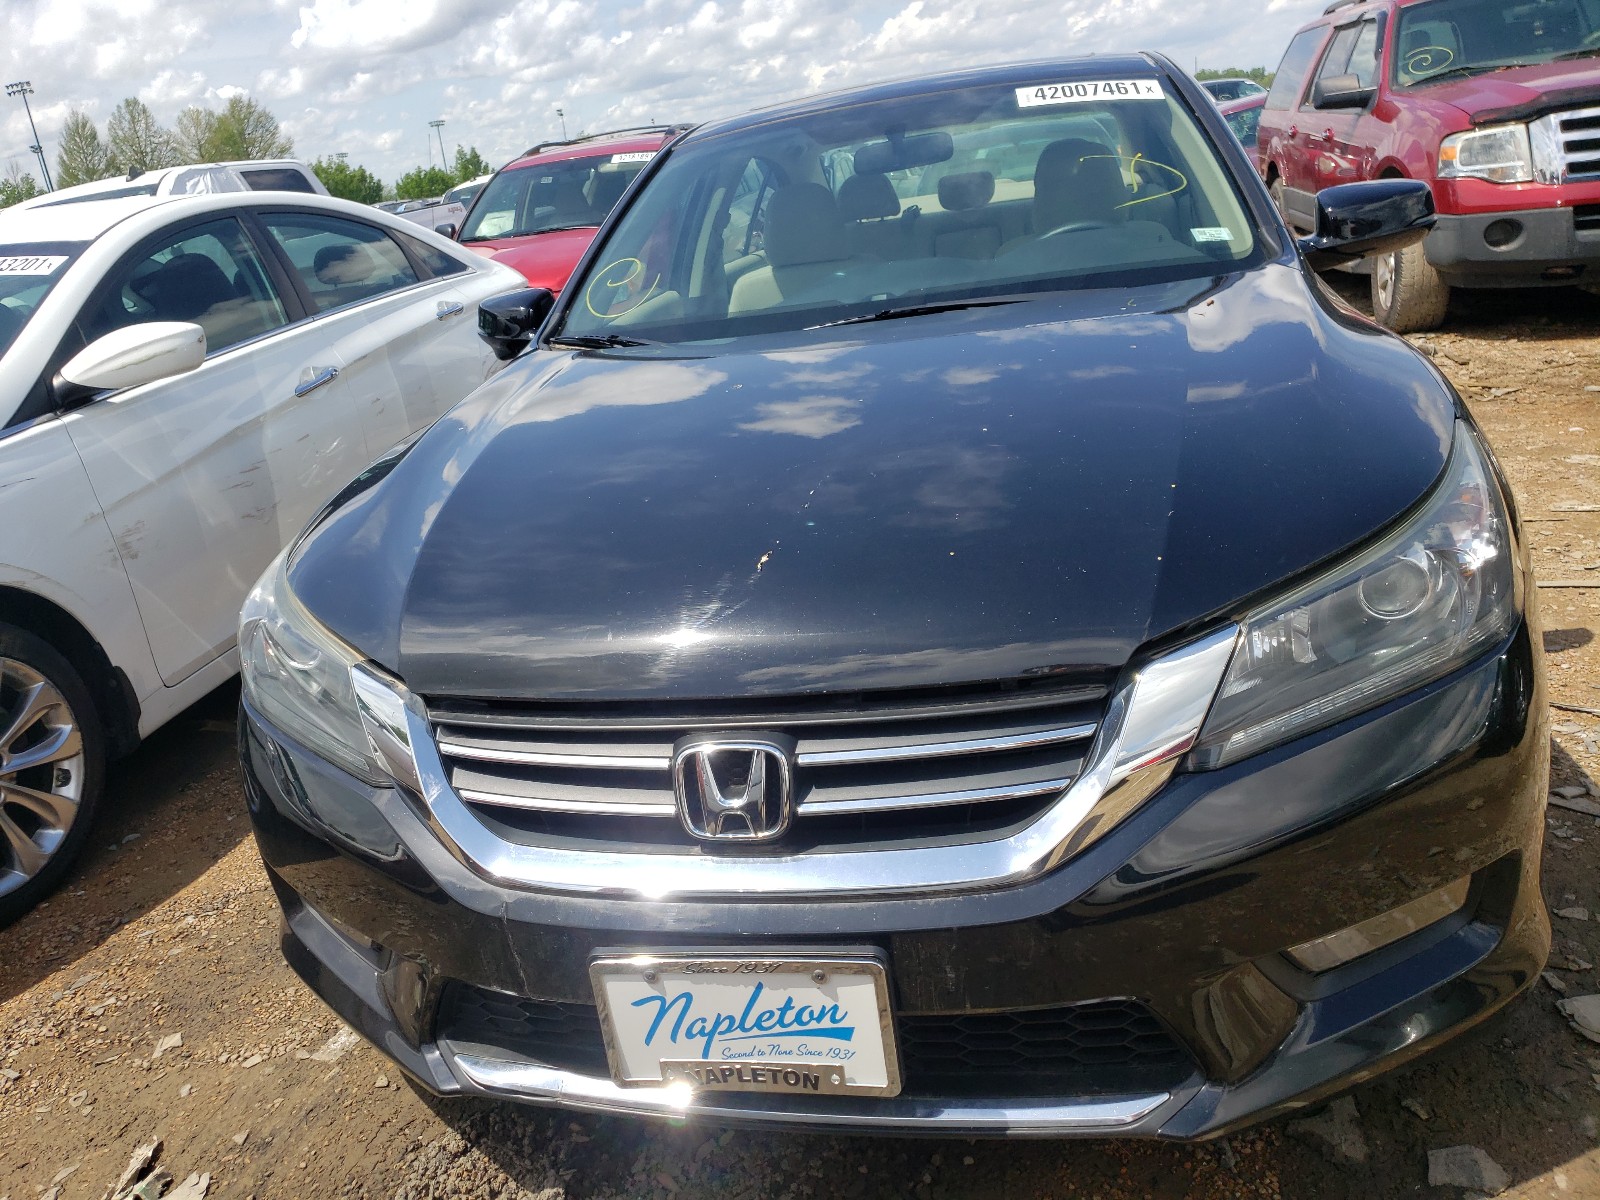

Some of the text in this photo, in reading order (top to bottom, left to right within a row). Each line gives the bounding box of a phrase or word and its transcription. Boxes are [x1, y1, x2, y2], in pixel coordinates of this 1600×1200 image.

[1034, 82, 1141, 100] 42007461
[682, 960, 785, 975] Since 1931
[630, 980, 849, 1060] Napleton
[721, 1043, 856, 1061] Second to None Since 1931
